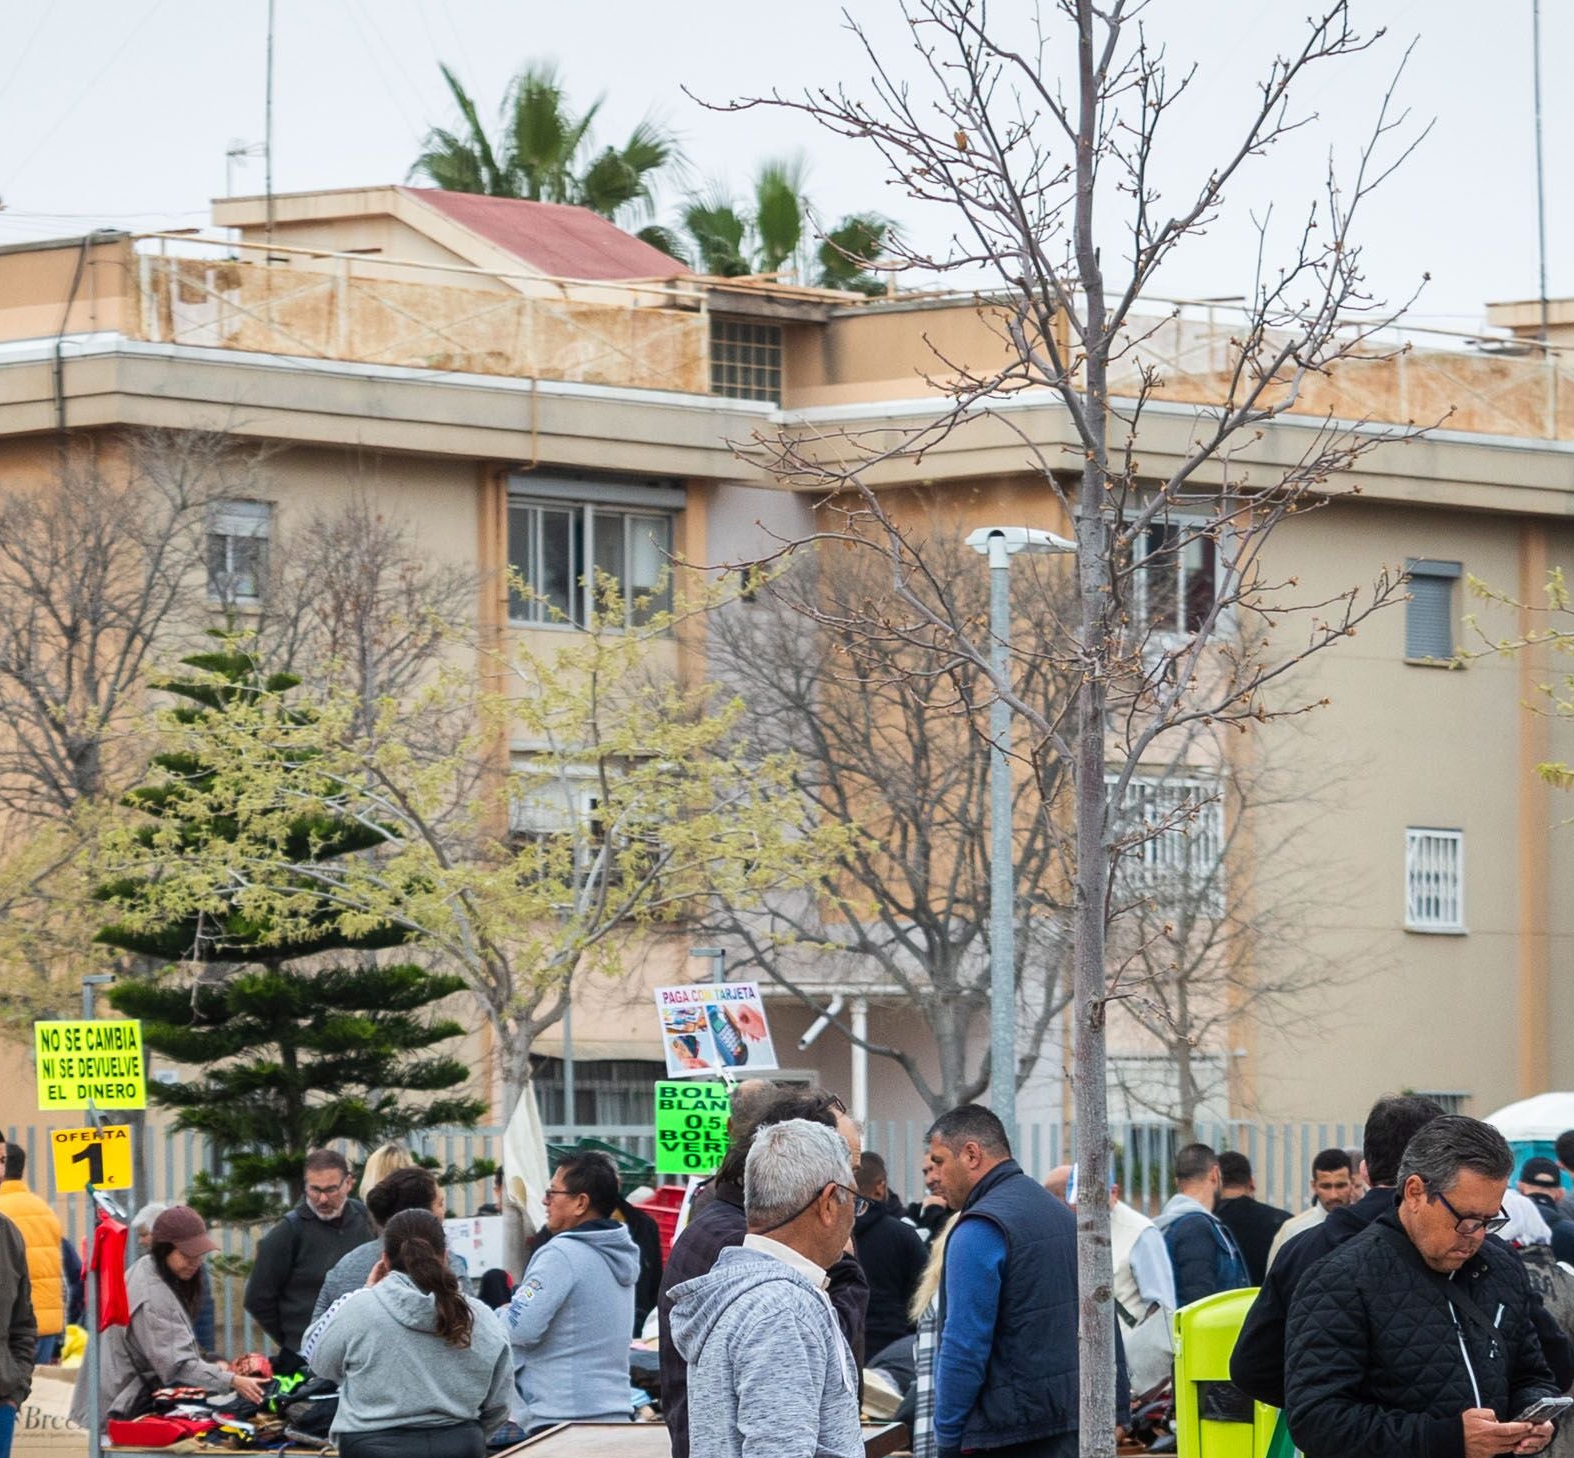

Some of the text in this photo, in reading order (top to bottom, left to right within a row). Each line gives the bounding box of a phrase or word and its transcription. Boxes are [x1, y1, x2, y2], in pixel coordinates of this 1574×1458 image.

[662, 990, 689, 1004] PAGA
[715, 987, 756, 1001] TARJETA
[41, 1027, 137, 1052] NO SE CAMBIA
[42, 1056, 139, 1079] NI SE DEVUELVE
[48, 1083, 136, 1100] EL DINERO
[660, 1087, 728, 1099] BOL
[661, 1142, 729, 1152] VER
[72, 1142, 104, 1184] 1
